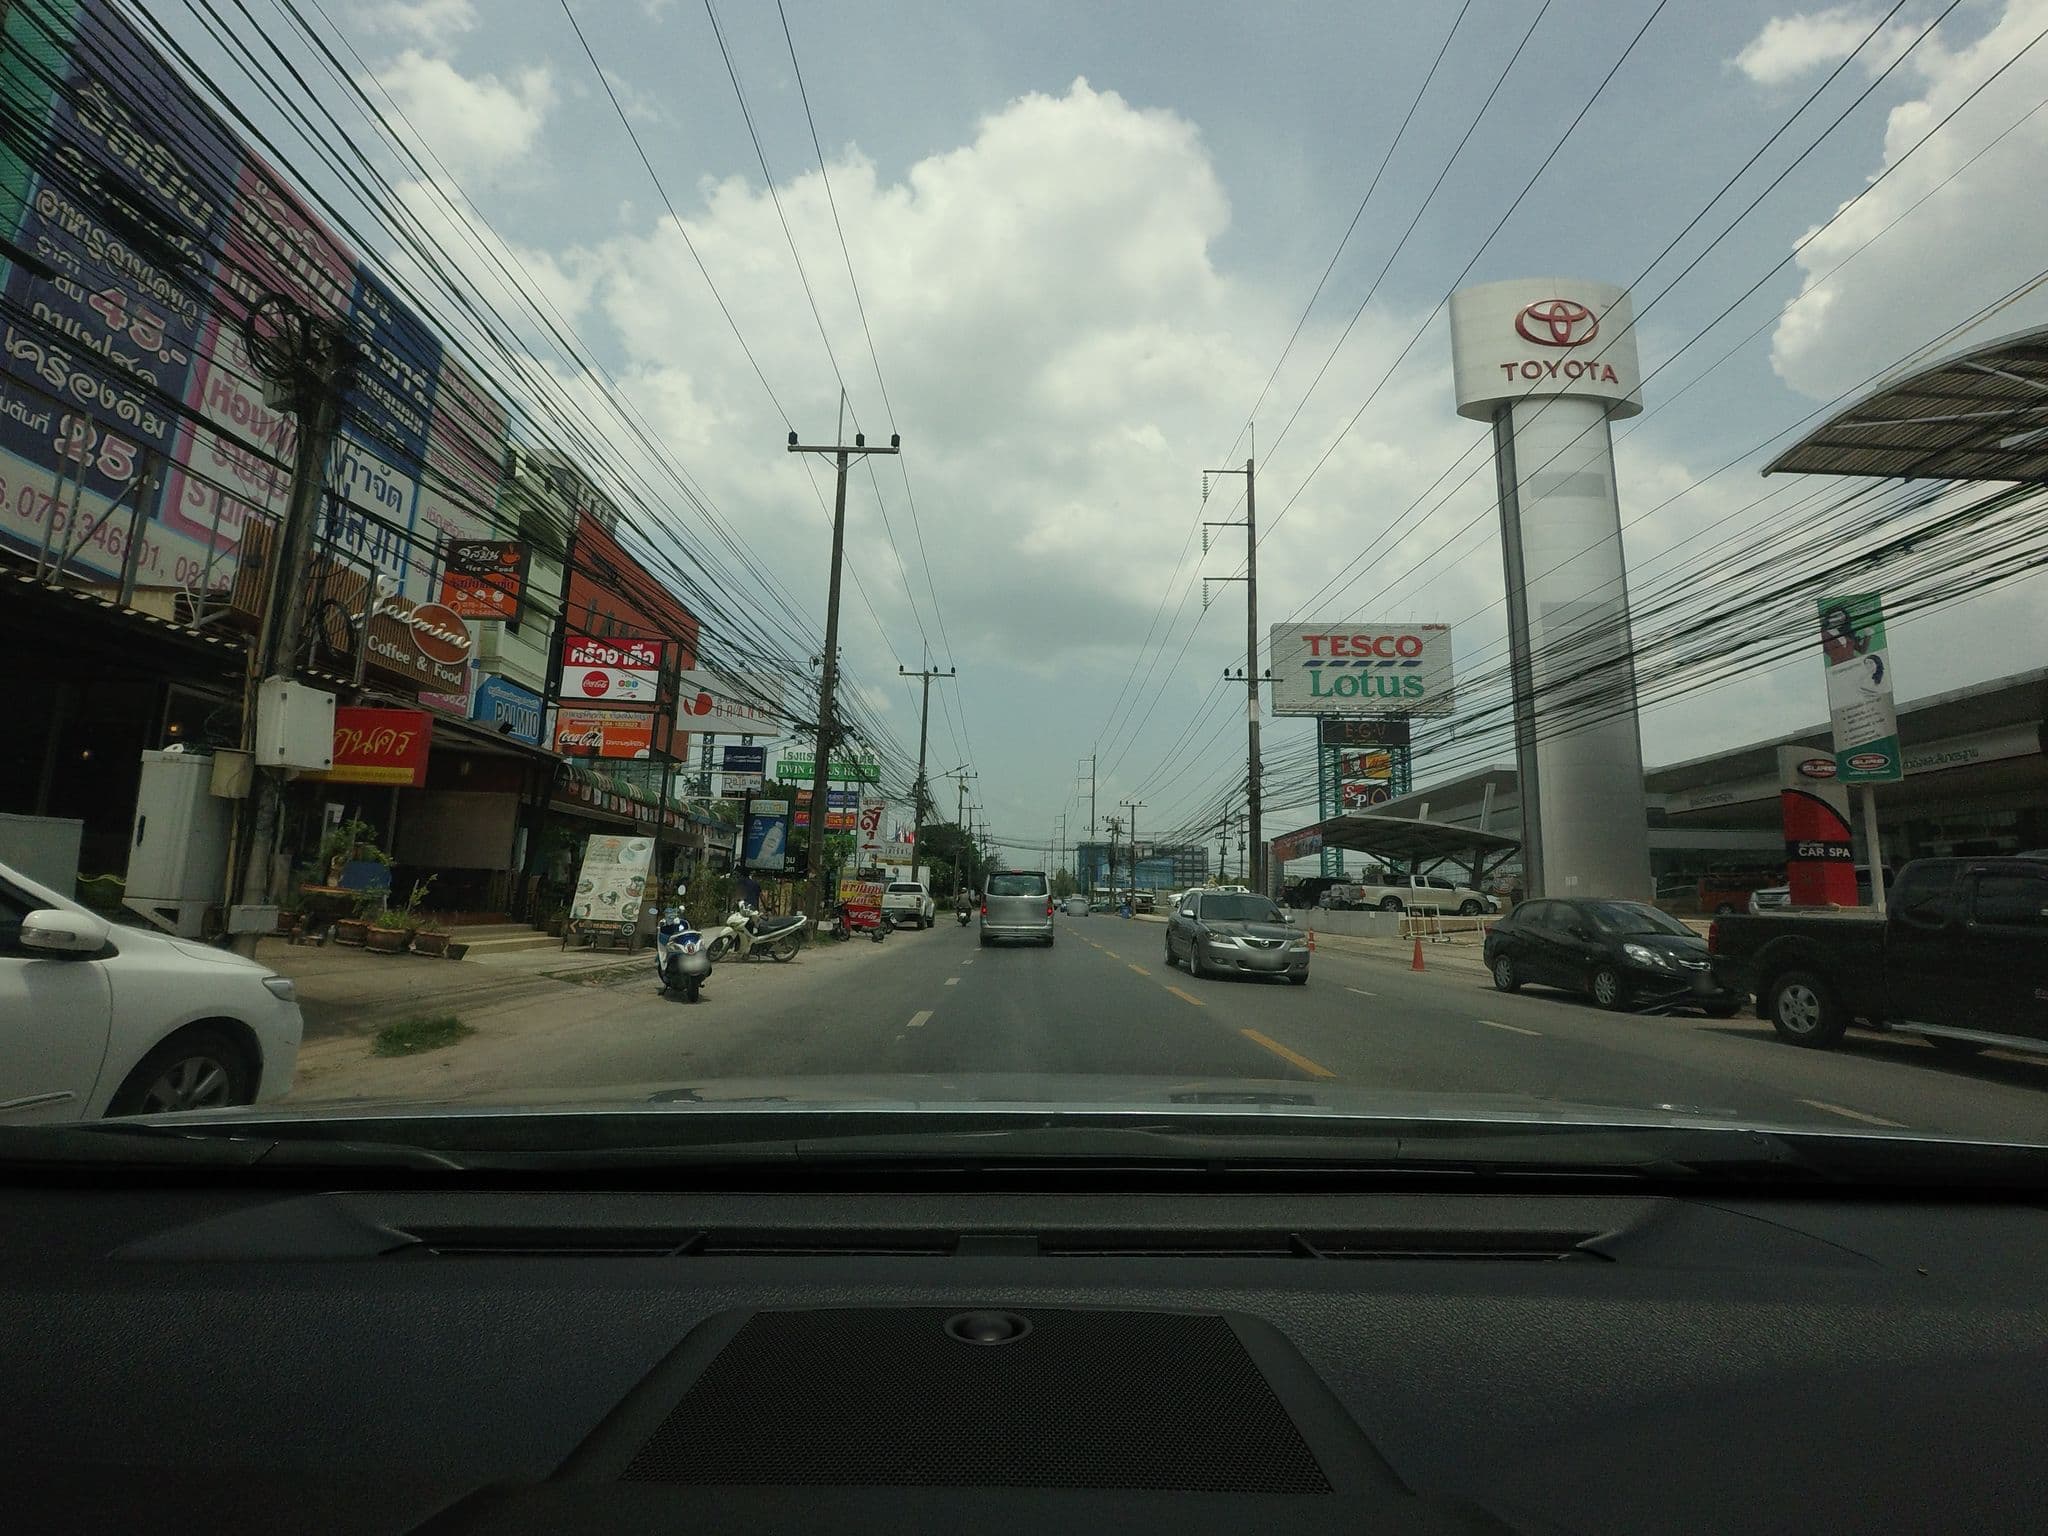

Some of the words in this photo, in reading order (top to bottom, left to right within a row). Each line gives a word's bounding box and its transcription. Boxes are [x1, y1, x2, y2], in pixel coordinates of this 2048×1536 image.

[1500, 360, 1619, 384] TOYOTA
[339, 447, 403, 513] กำจัด
[350, 574, 472, 649] Jasmine
[1302, 635, 1423, 658] TESCO
[368, 635, 410, 665] Coffee
[416, 655, 427, 672] &
[434, 663, 462, 686] Food
[1309, 669, 1424, 698] Lotus
[778, 765, 805, 774] TWIN
[1798, 847, 1825, 857] CAR
[1829, 848, 1851, 858] SPA
